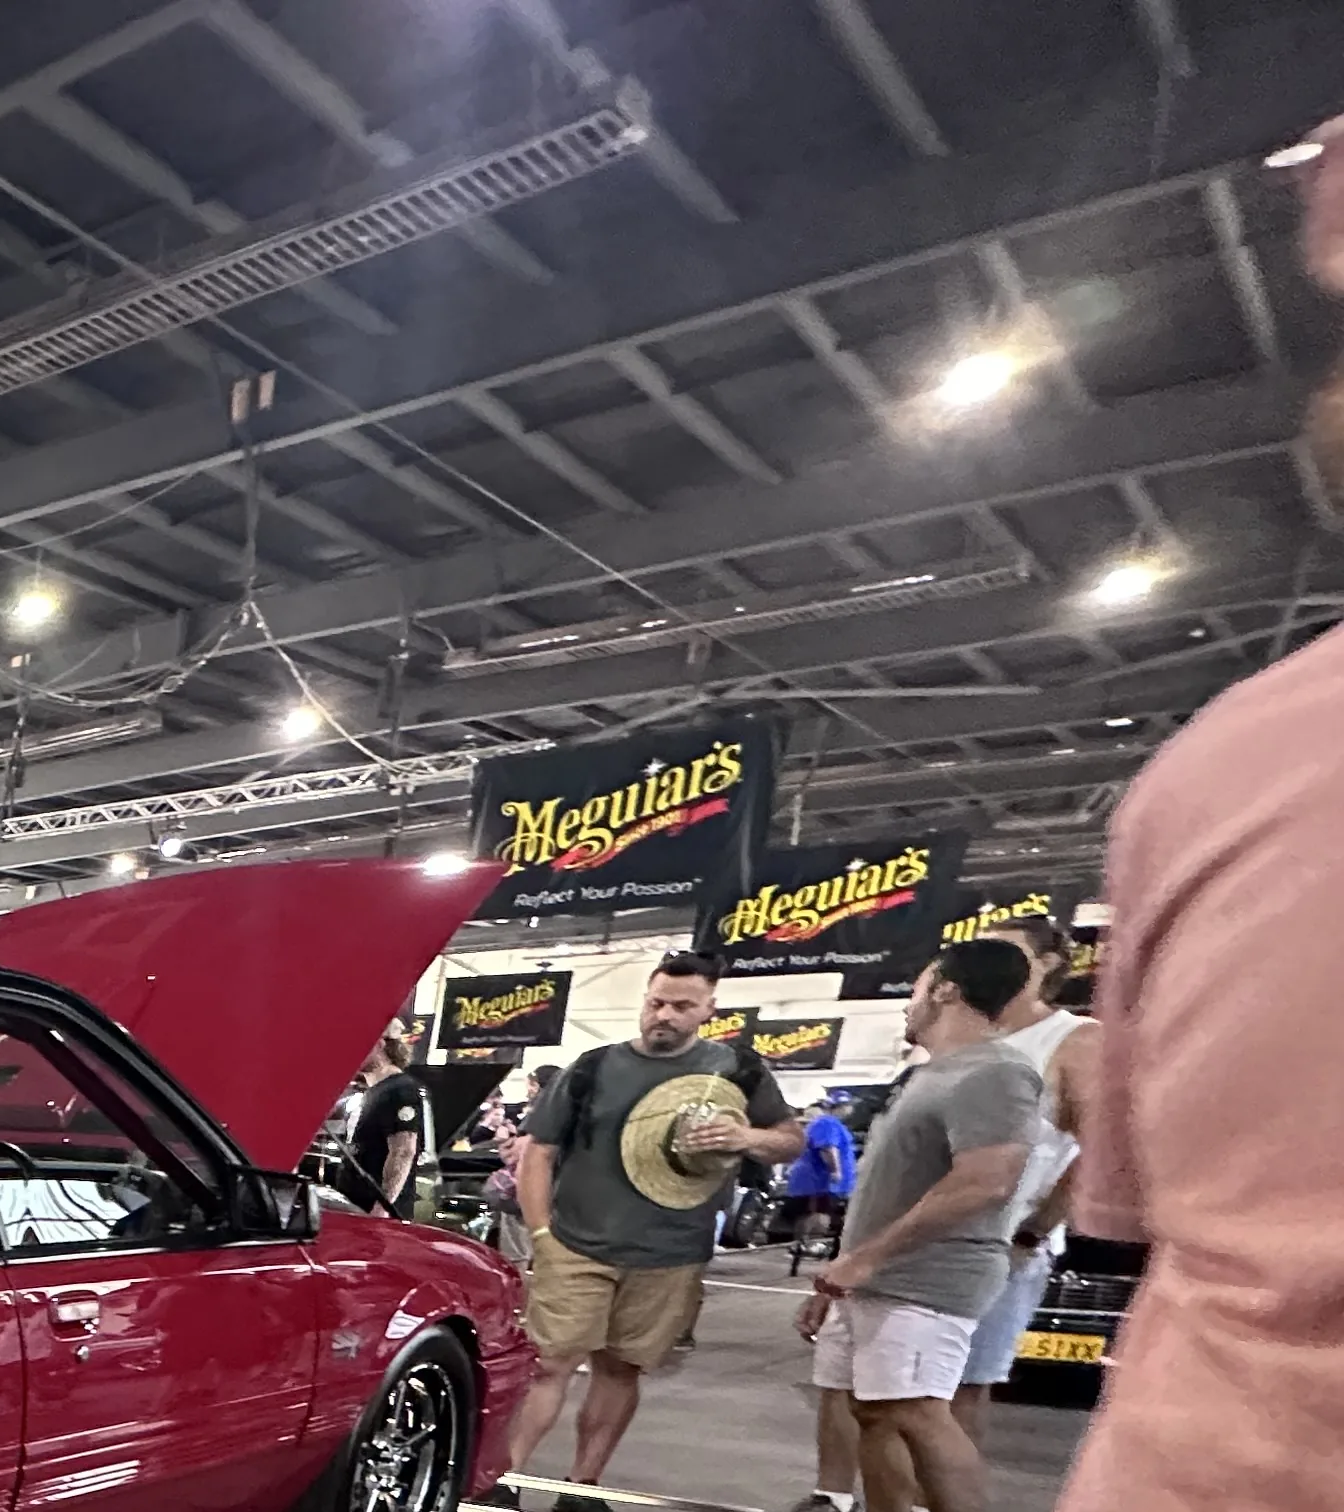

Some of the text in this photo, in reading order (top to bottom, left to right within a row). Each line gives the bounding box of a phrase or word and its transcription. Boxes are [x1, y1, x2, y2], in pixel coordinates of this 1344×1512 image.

[494, 741, 742, 877] Meguiar's
[514, 889, 576, 909] Reflect
[581, 884, 619, 900] Your
[717, 847, 930, 945] Meguiar's
[454, 979, 557, 1032] Meguiar's
